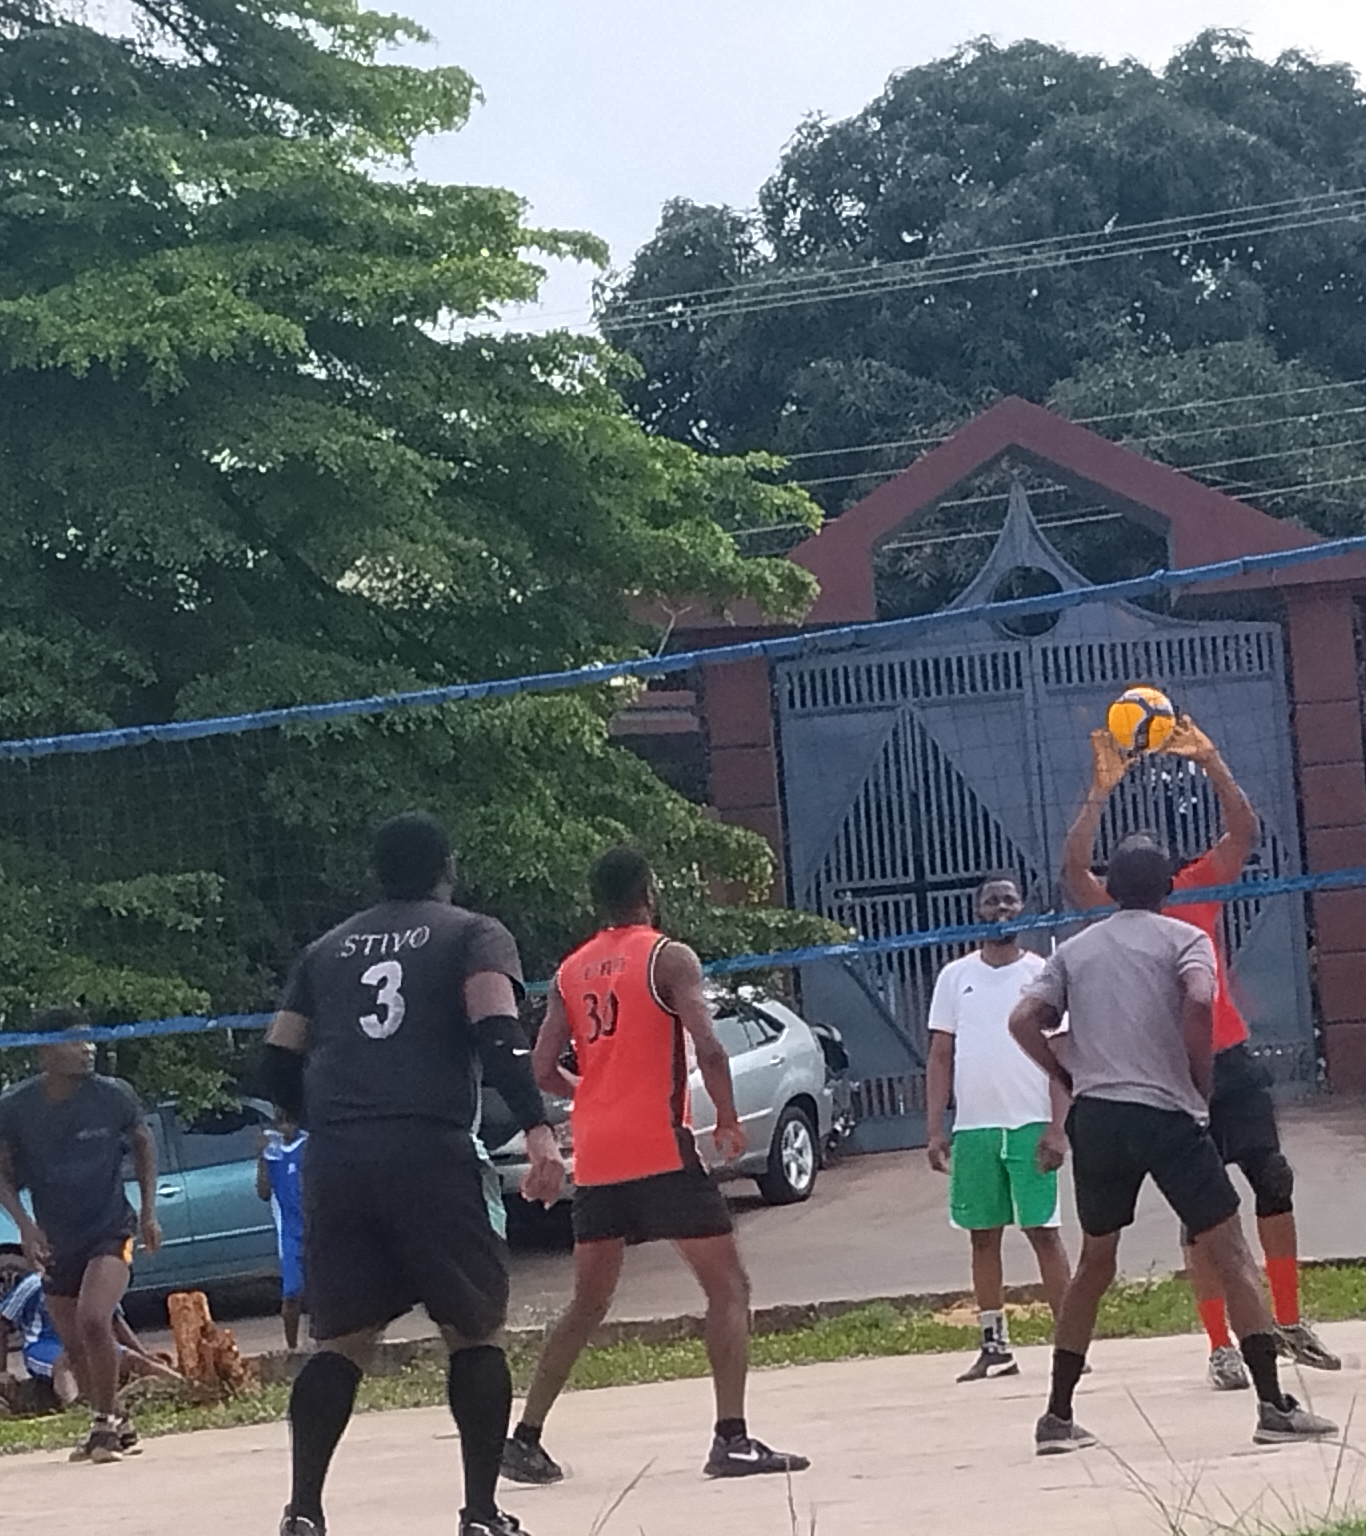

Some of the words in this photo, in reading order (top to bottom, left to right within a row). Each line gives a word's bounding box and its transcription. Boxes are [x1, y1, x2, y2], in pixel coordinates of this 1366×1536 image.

[340, 925, 431, 957] STIVO
[359, 960, 406, 1039] 3
[582, 990, 620, 1045] 30
